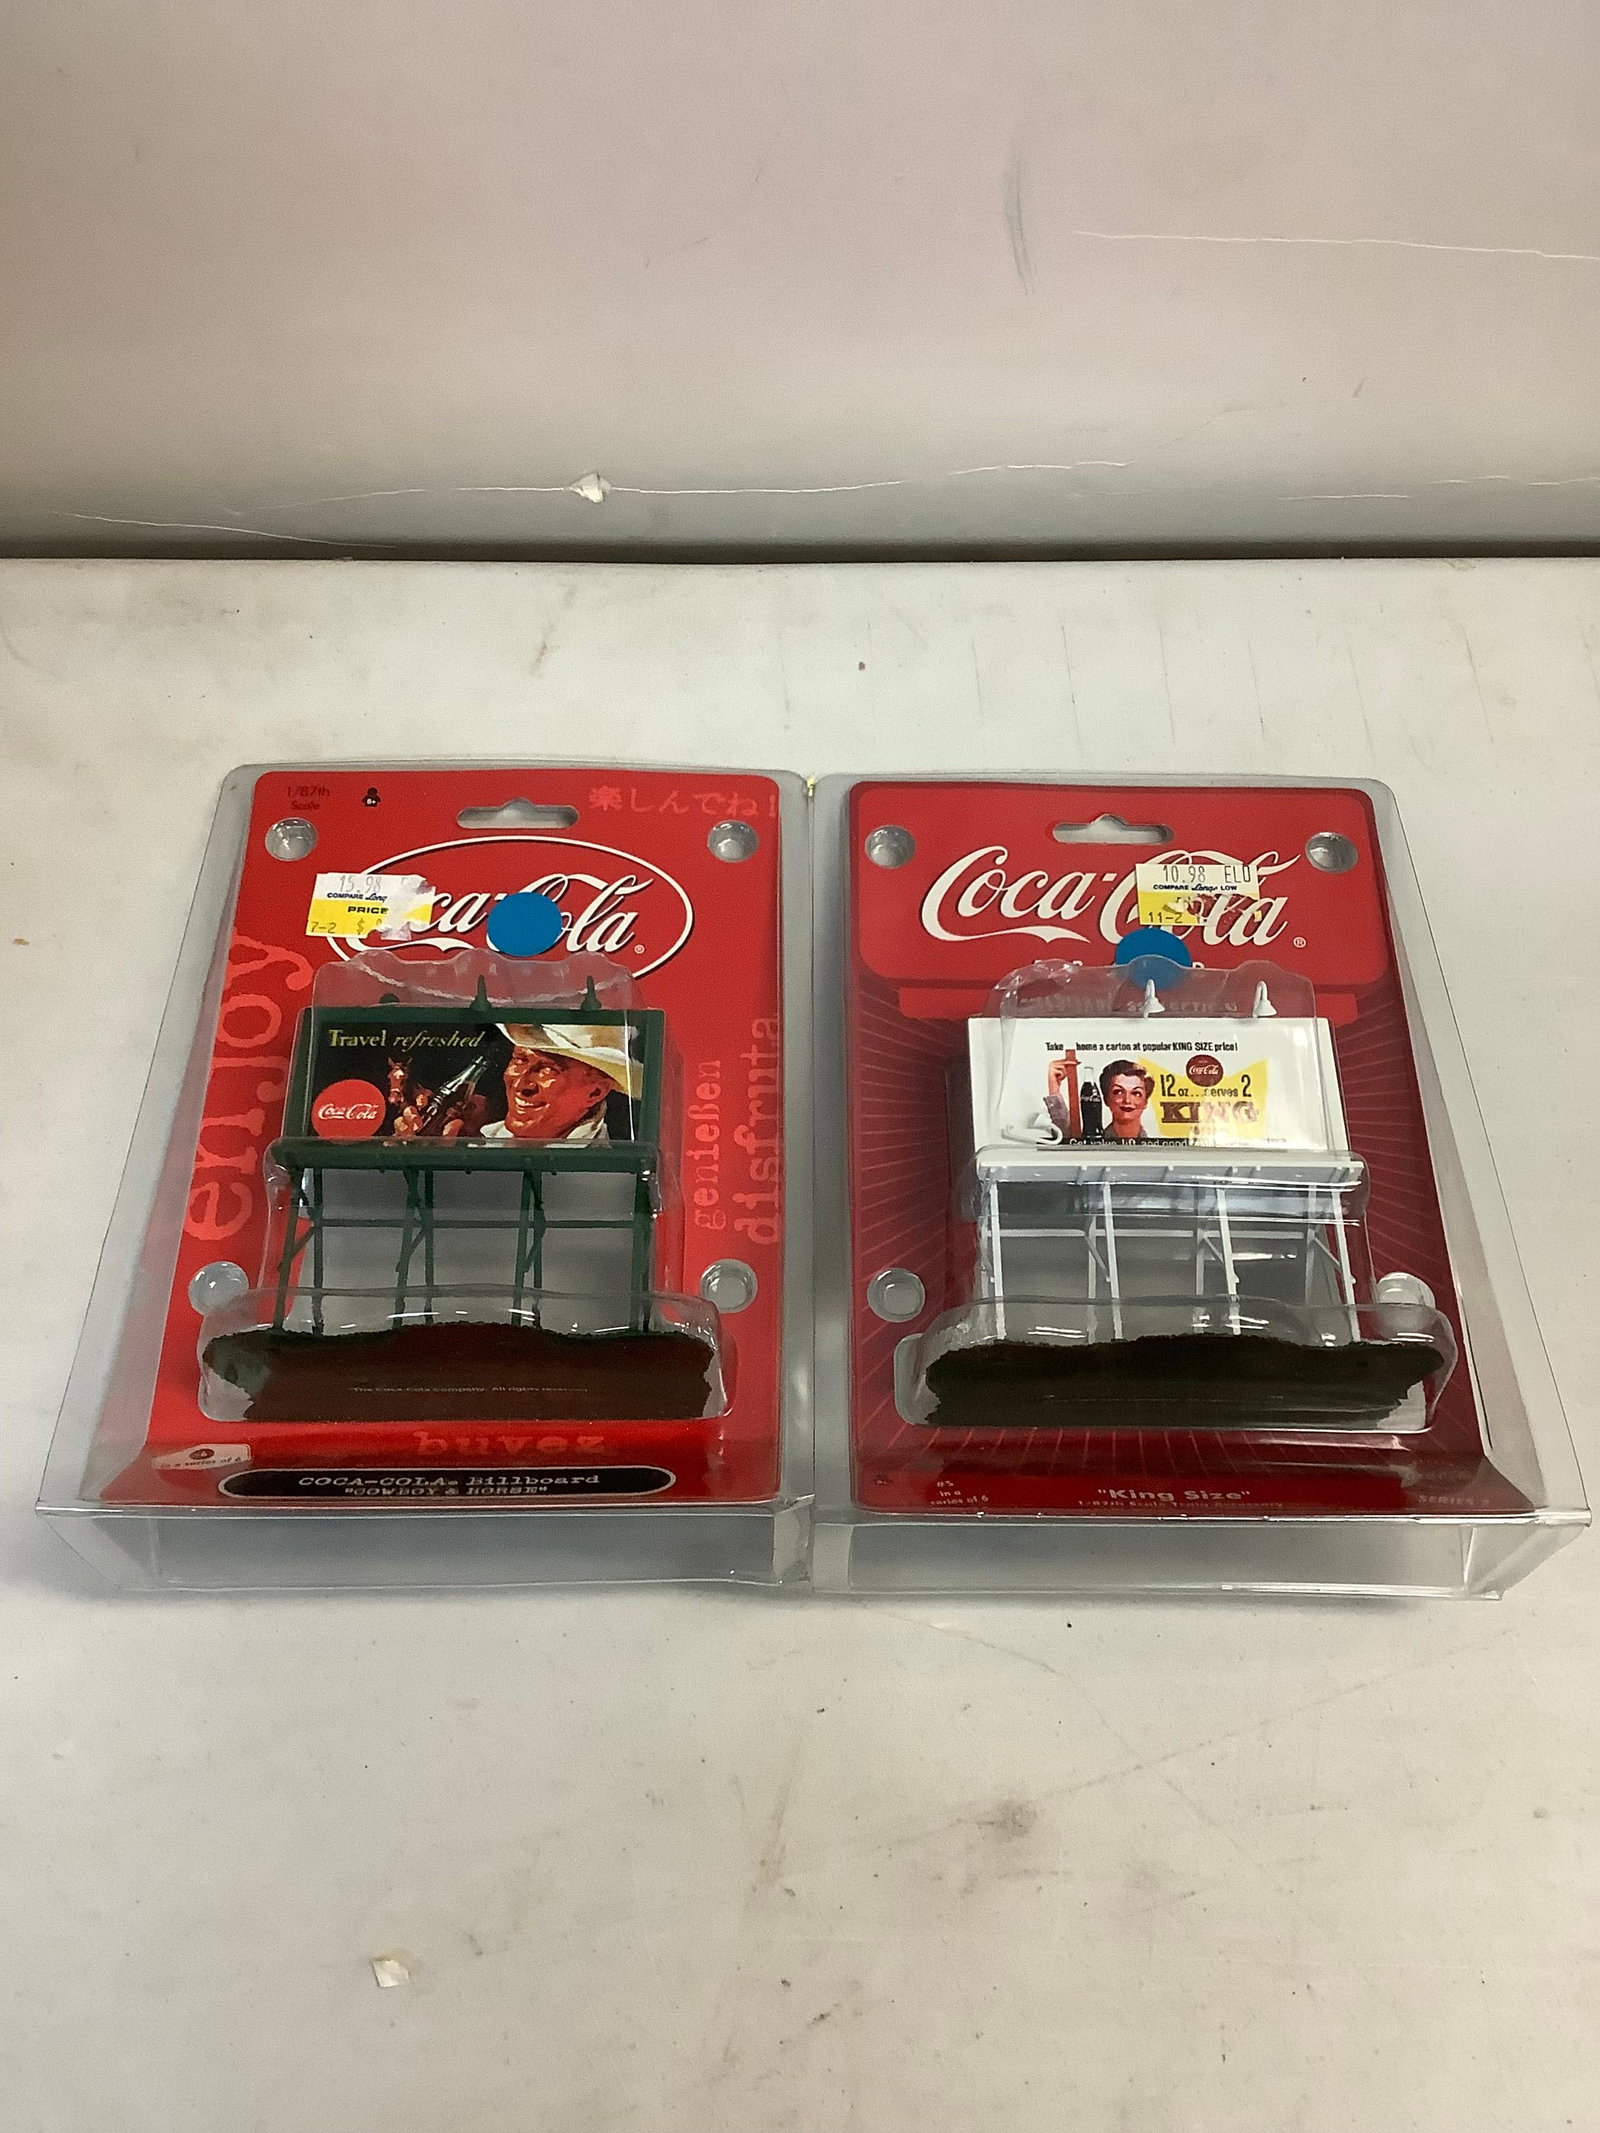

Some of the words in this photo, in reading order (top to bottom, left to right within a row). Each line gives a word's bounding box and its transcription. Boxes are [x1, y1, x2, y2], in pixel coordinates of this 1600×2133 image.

[1162, 865, 1206, 883] 10.98
[347, 905, 389, 914] PRICE
[328, 1029, 387, 1047] Travel
[393, 1030, 486, 1053] refreshed
[1046, 1042, 1064, 1051] Take
[1076, 1042, 1097, 1051] home
[1106, 1043, 1131, 1051] carton
[1133, 1043, 1140, 1051] at
[1142, 1042, 1171, 1053] popular
[1172, 1042, 1193, 1051] KING
[1194, 1042, 1213, 1051] SIZE
[1160, 1074, 1176, 1097] 12
[1242, 1074, 1252, 1098] 2
[317, 1103, 379, 1120] Coca-Cola
[1160, 1101, 1260, 1123] KING
[464, 1474, 601, 1486] Billboard
[1097, 1489, 1175, 1501] "King
[1183, 1489, 1251, 1501] Size"
